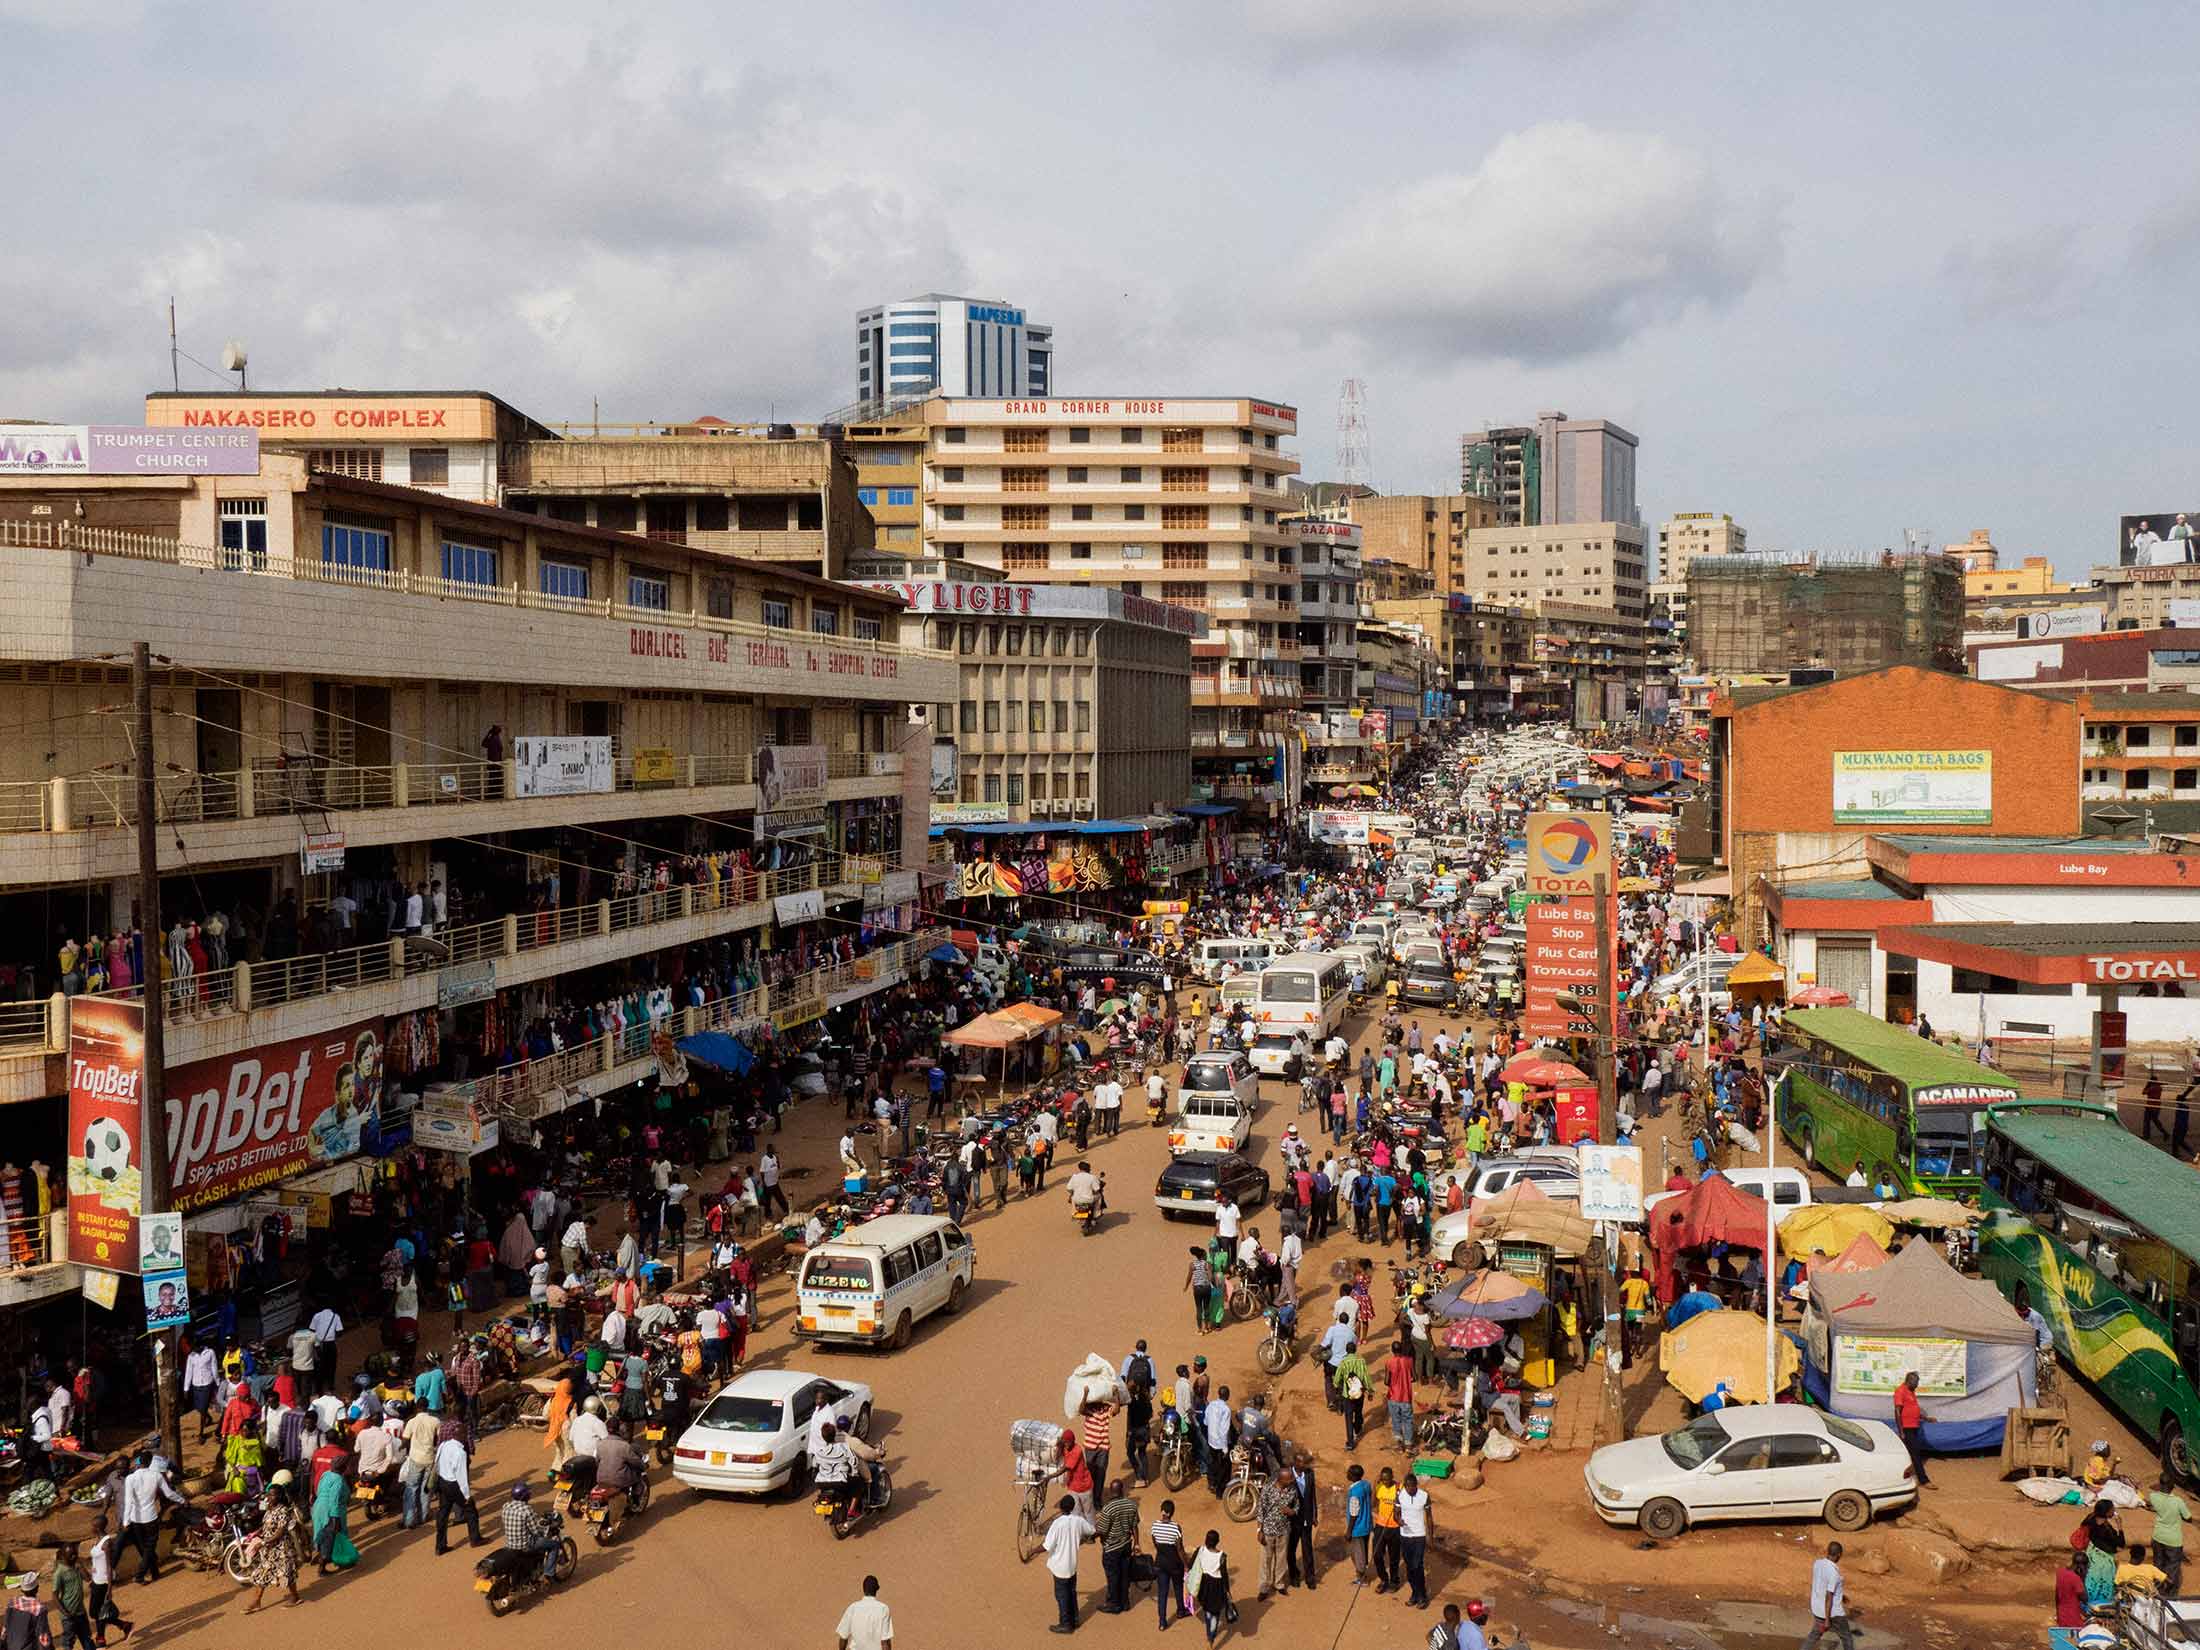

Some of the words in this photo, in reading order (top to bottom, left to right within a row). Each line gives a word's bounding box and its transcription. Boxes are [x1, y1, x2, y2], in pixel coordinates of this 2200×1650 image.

[1006, 401, 1047, 414] GRAND
[1062, 401, 1110, 414] CORNER
[1125, 401, 1164, 414] HOUSE
[184, 410, 317, 427] NAKASERO
[334, 410, 446, 428] COMPLEX
[93, 434, 176, 448] TRUMPET
[182, 434, 249, 448] CENTRE
[22, 462, 53, 470] trumpet
[135, 454, 208, 467] CHURCH
[2127, 569, 2176, 581] ASTORIA
[852, 583, 1035, 613] YLIGHT
[708, 638, 729, 663] BUS
[746, 641, 790, 668] TERMINAL
[828, 652, 865, 676] SHOPPING
[872, 657, 898, 679] CENTER
[1842, 753, 1913, 765] MUKWANO
[1919, 753, 1943, 764] TEA
[1948, 752, 1985, 764] BAGS
[2060, 863, 2085, 873] Lube
[2088, 864, 2108, 876] Bay
[1532, 876, 1593, 892] TOTA
[1538, 908, 1569, 920] Lube
[1574, 908, 1596, 923] Bay
[1552, 928, 1585, 941] Shop
[1538, 947, 1563, 959] Plus
[1568, 947, 1598, 959] Card
[2088, 957, 2197, 980] TOTAL
[73, 1059, 138, 1099] TopBet
[165, 1051, 313, 1190] pBet
[240, 1140, 288, 1167] BETTING
[289, 1135, 309, 1153] LTD
[193, 1183, 229, 1207] CASH
[238, 1159, 309, 1193] KAGWILAWO
[108, 1217, 130, 1230] CASH
